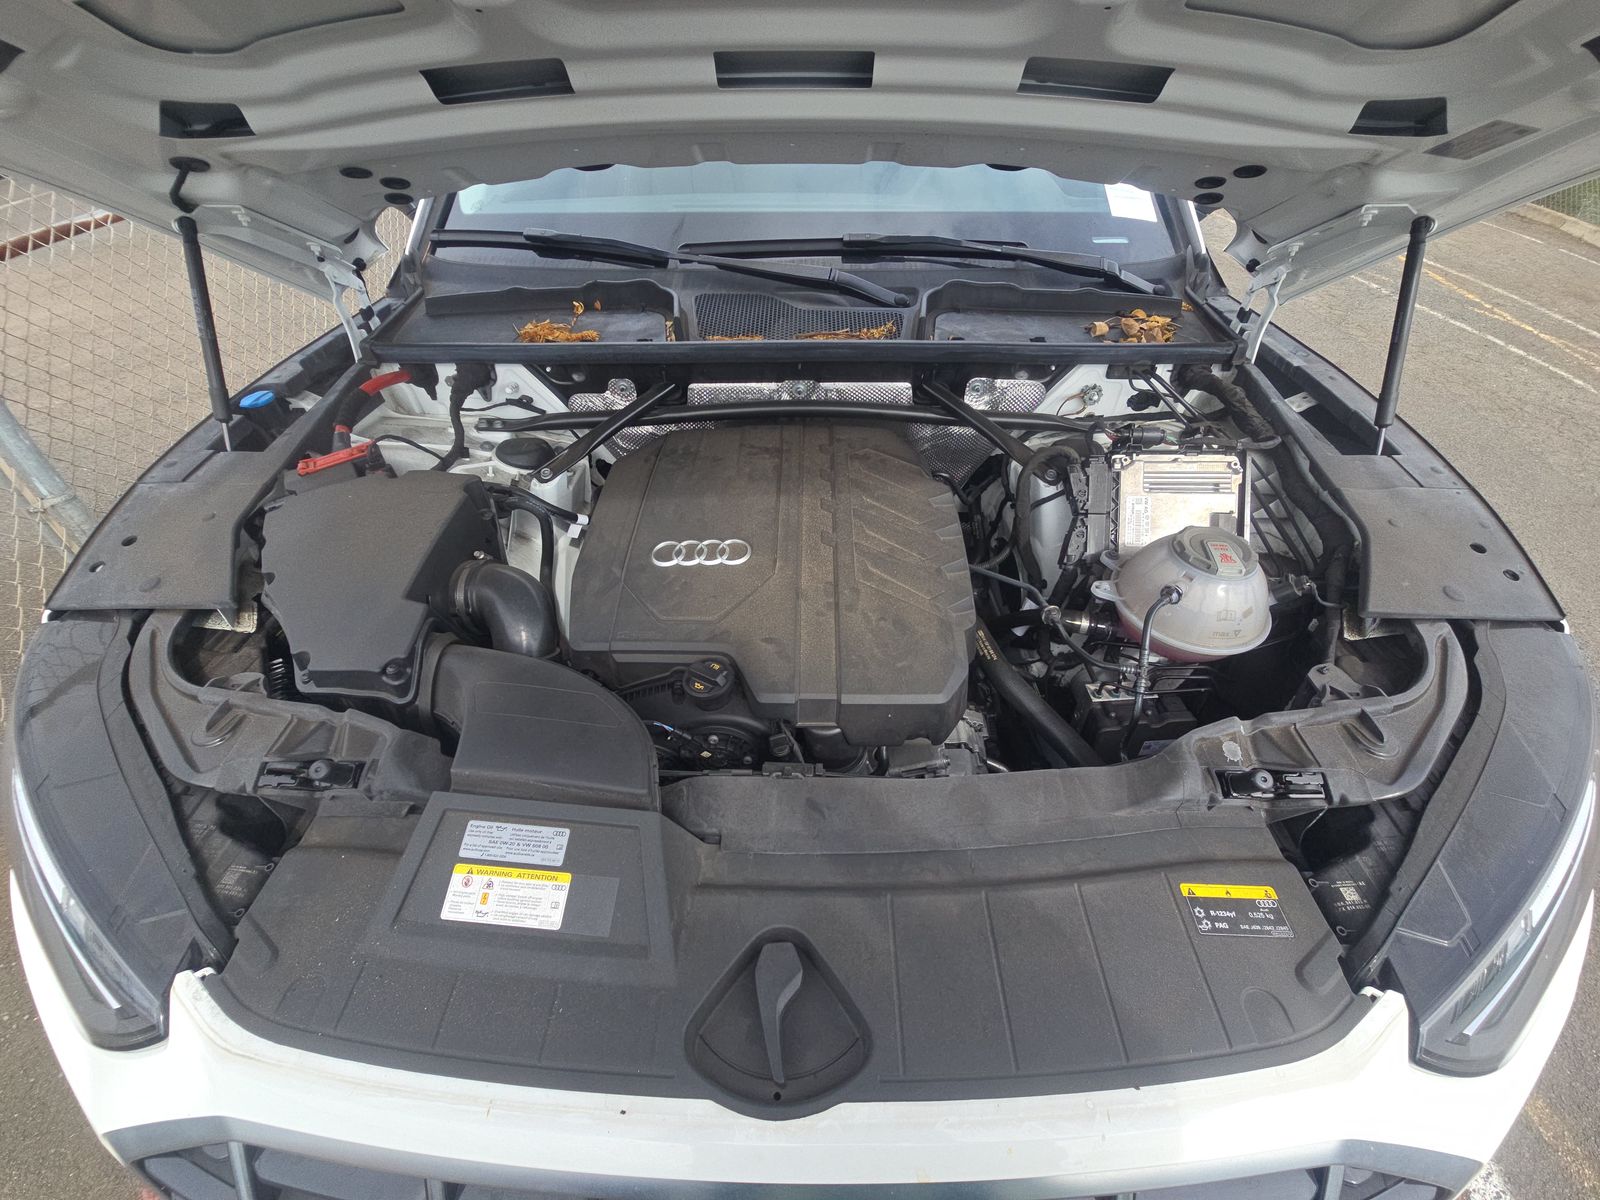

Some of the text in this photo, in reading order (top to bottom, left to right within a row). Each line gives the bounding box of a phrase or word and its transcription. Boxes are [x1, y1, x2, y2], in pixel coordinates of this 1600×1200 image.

[476, 869, 559, 882] WARNING ATTENTION
[1210, 910, 1236, 918] R-1234yf
